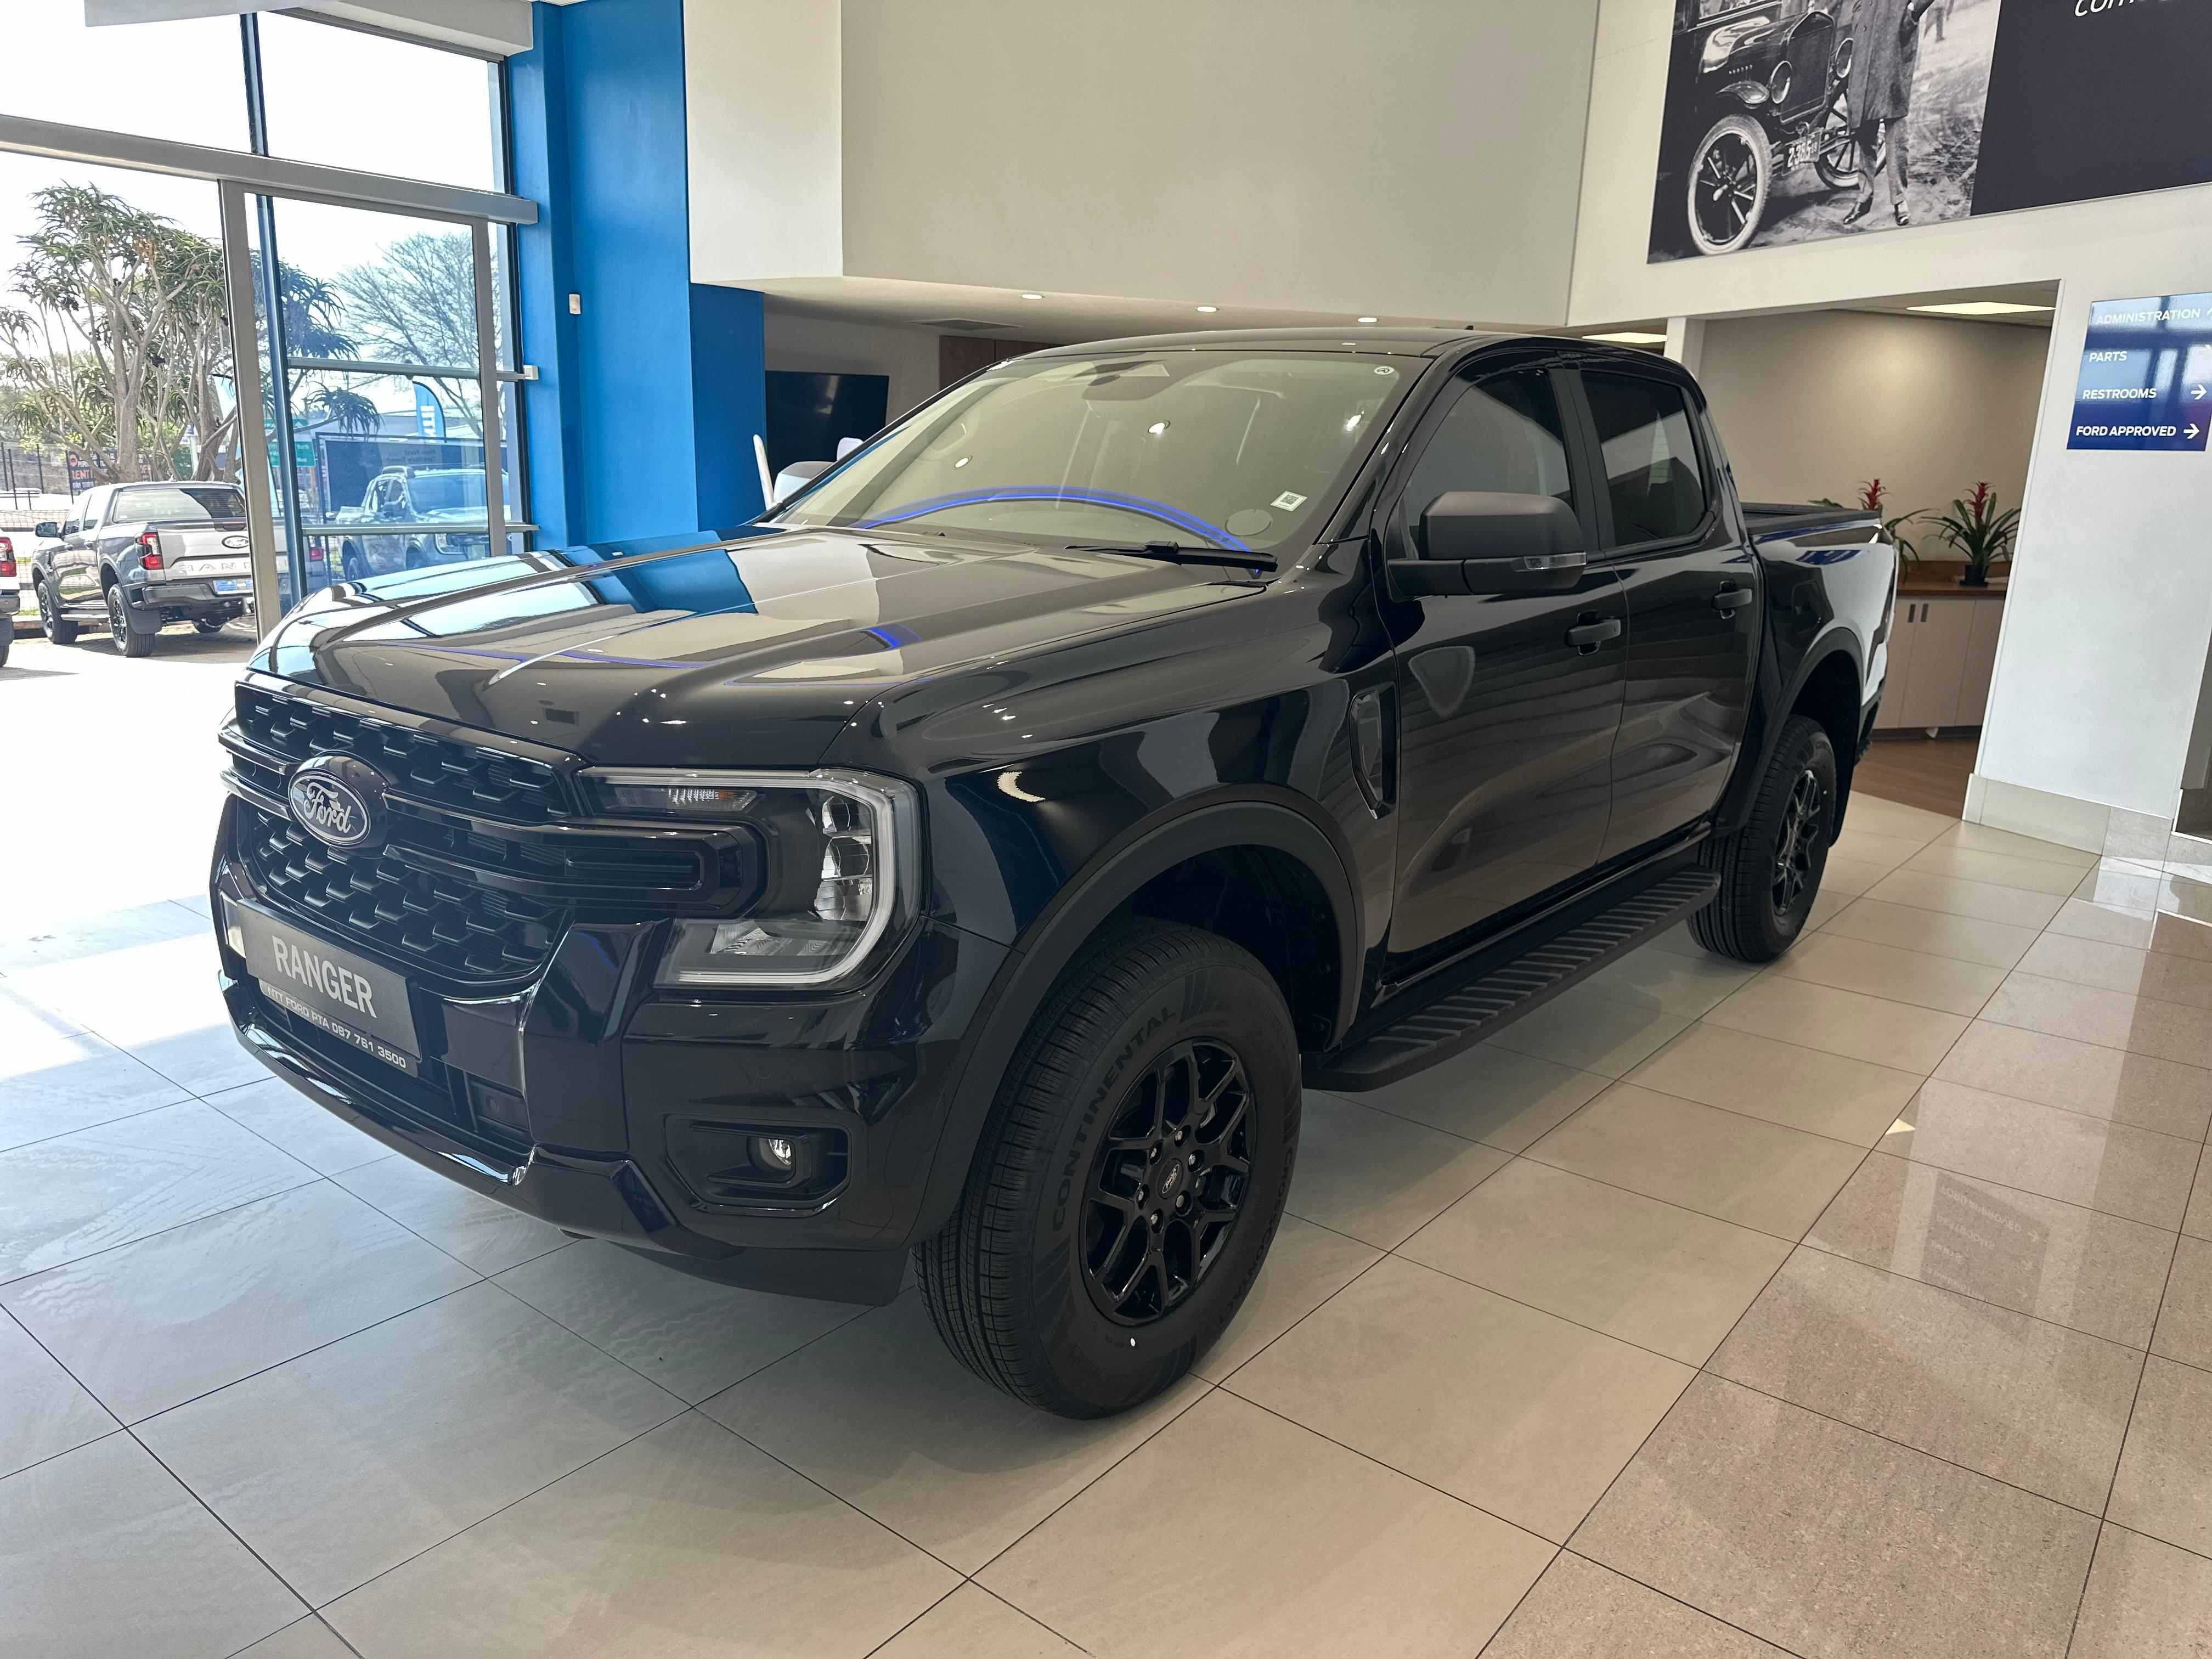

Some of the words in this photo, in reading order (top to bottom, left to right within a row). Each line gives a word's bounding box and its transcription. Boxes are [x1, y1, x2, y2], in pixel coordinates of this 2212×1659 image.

[2095, 308, 2200, 324] ADMINISTRATION
[2089, 351, 2128, 362] PARTS
[2083, 388, 2157, 399] RESTROOMS
[2076, 426, 2108, 436] FORD
[2109, 426, 2176, 437] APPROVED
[303, 782, 351, 833] Ford
[272, 935, 377, 1018] RANGER
[268, 985, 284, 1002] NTT
[286, 998, 309, 1017] FORD
[312, 1011, 330, 1029] PTA
[332, 1022, 351, 1039] 087
[354, 1034, 374, 1052] 761
[377, 1046, 406, 1068] 3500
[1053, 1008, 1176, 1231] CONTINENTAL
